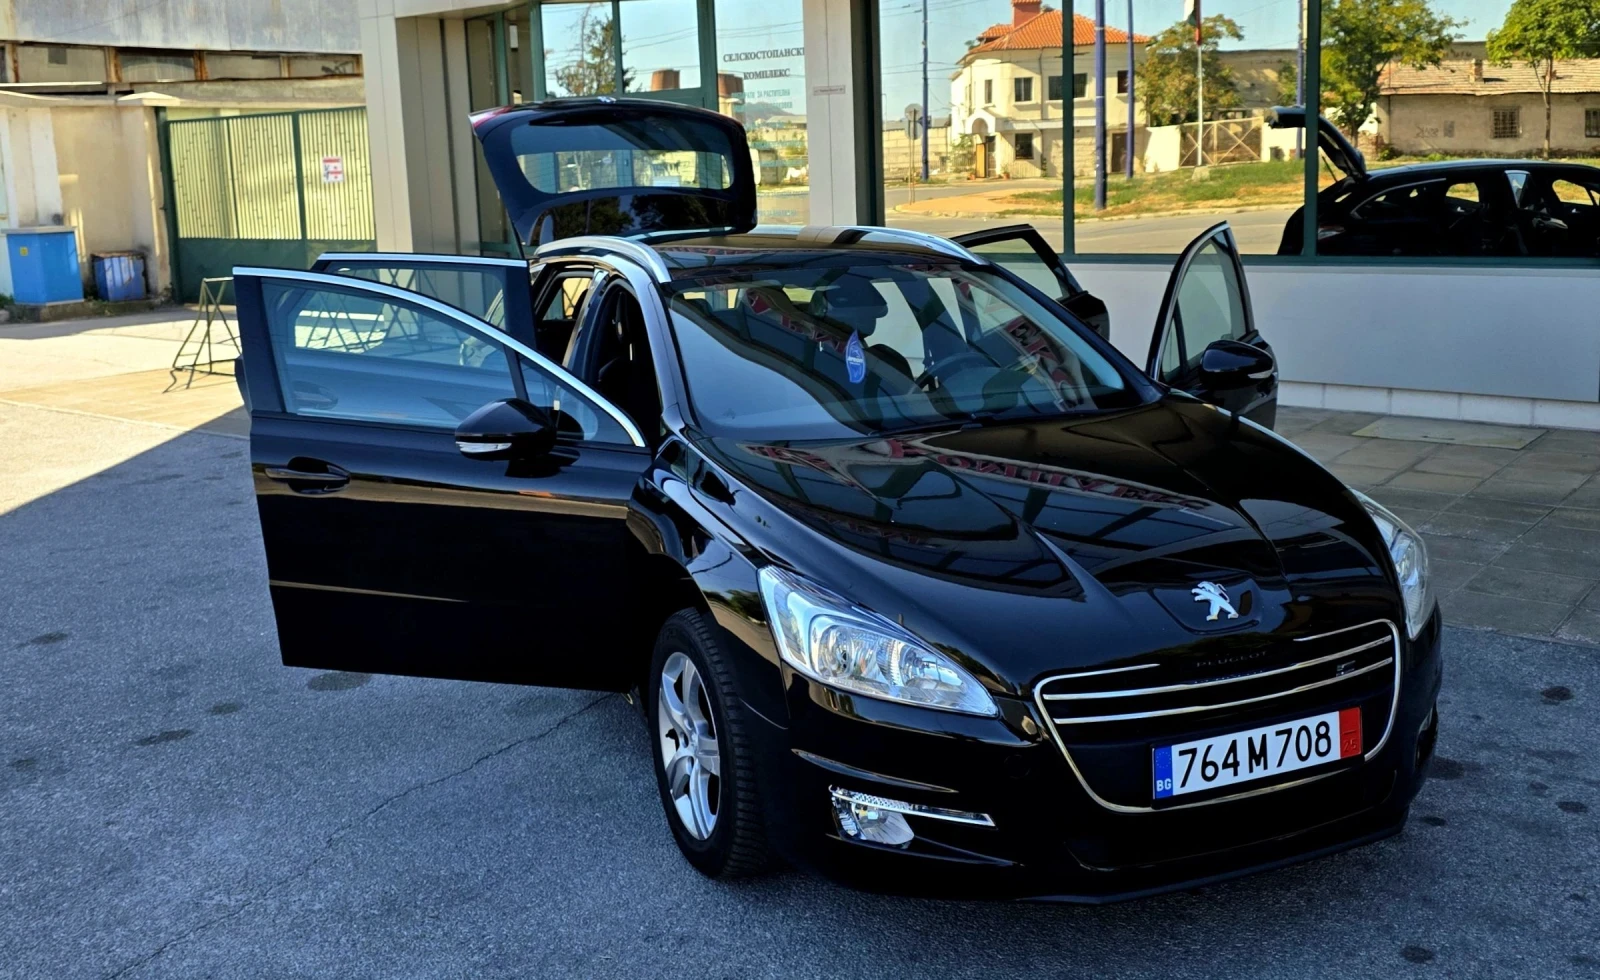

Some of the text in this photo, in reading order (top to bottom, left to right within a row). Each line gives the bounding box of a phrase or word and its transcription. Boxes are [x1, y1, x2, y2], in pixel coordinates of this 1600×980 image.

[743, 68, 790, 80] КОМПЛЕКС
[1196, 650, 1267, 668] PEUGEOT
[1156, 778, 1172, 792] BG
